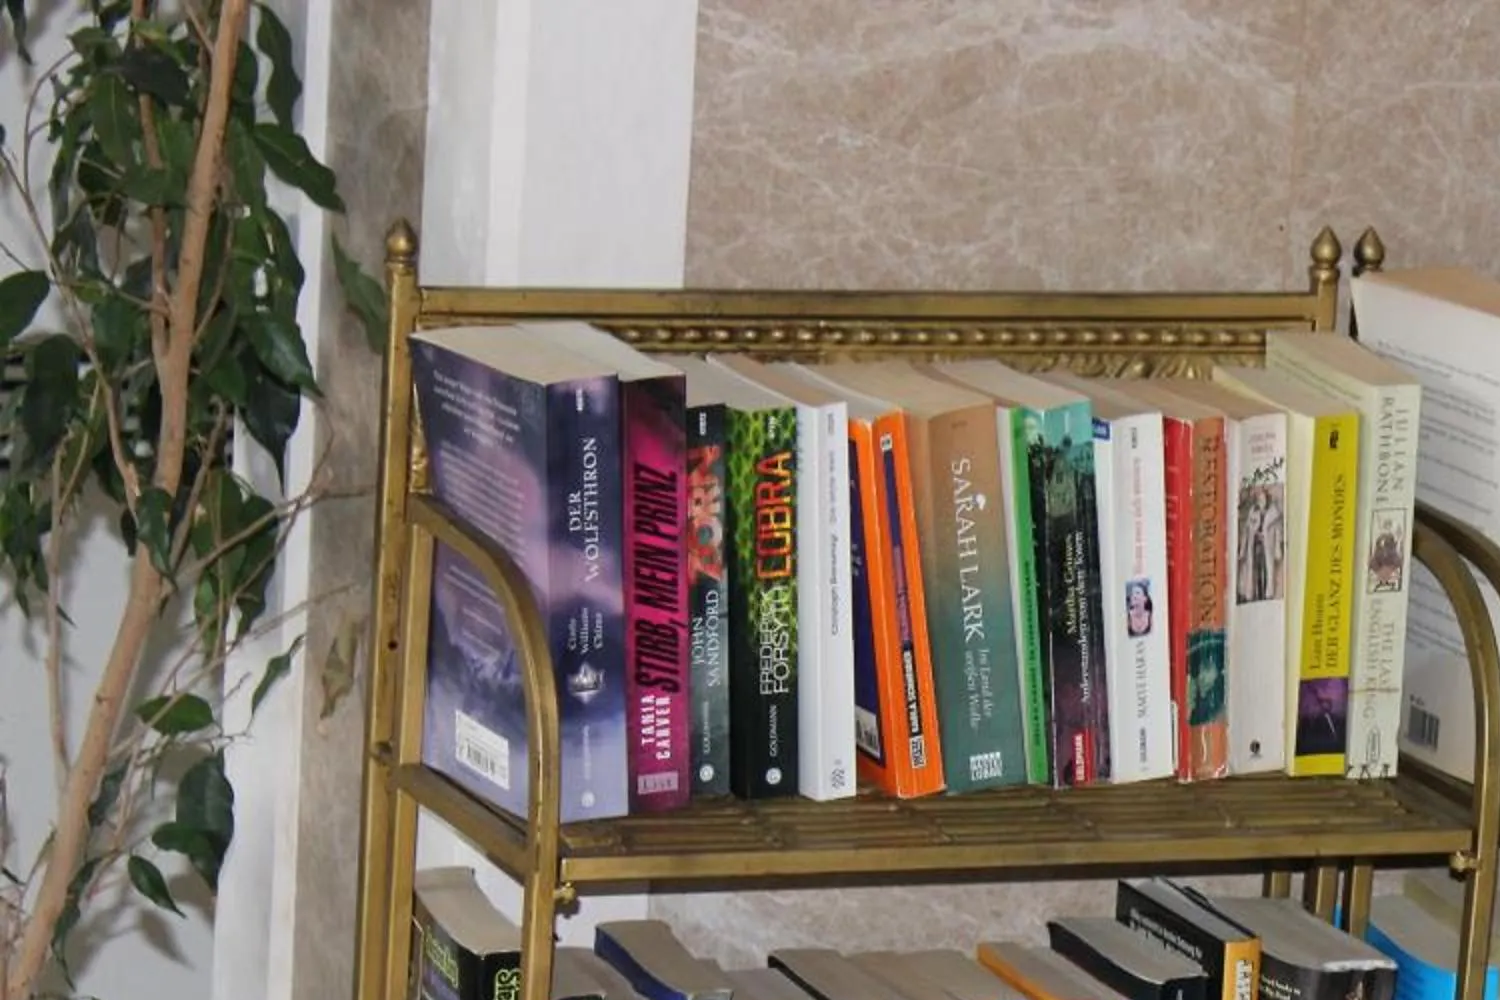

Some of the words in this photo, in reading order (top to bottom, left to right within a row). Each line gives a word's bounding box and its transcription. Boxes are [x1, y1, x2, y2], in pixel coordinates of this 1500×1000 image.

[1374, 396, 1394, 503] RATHBONE
[1392, 408, 1409, 491] JULIAN
[569, 491, 581, 532] DER
[581, 438, 599, 581] WOLFSTHRON
[633, 463, 677, 537] PRINZ
[756, 452, 793, 578] COBRA
[951, 458, 977, 558] SARAH
[1201, 434, 1220, 622] RESTORATION
[1333, 474, 1346, 544] MONDES
[634, 540, 679, 614] MEIN
[1331, 548, 1342, 576] DES
[691, 617, 705, 664] JOHN
[706, 591, 720, 686] SANDFORD
[774, 586, 789, 693] FORSYTH
[960, 566, 984, 643] LARK
[1327, 580, 1341, 637] GLANZ
[635, 618, 685, 693] STIRB,
[761, 590, 774, 694] FREDERICK
[1325, 640, 1337, 668] DER
[641, 695, 657, 745] TANIA
[656, 696, 671, 760] CARVER
[769, 705, 777, 757] GOLDMANN
